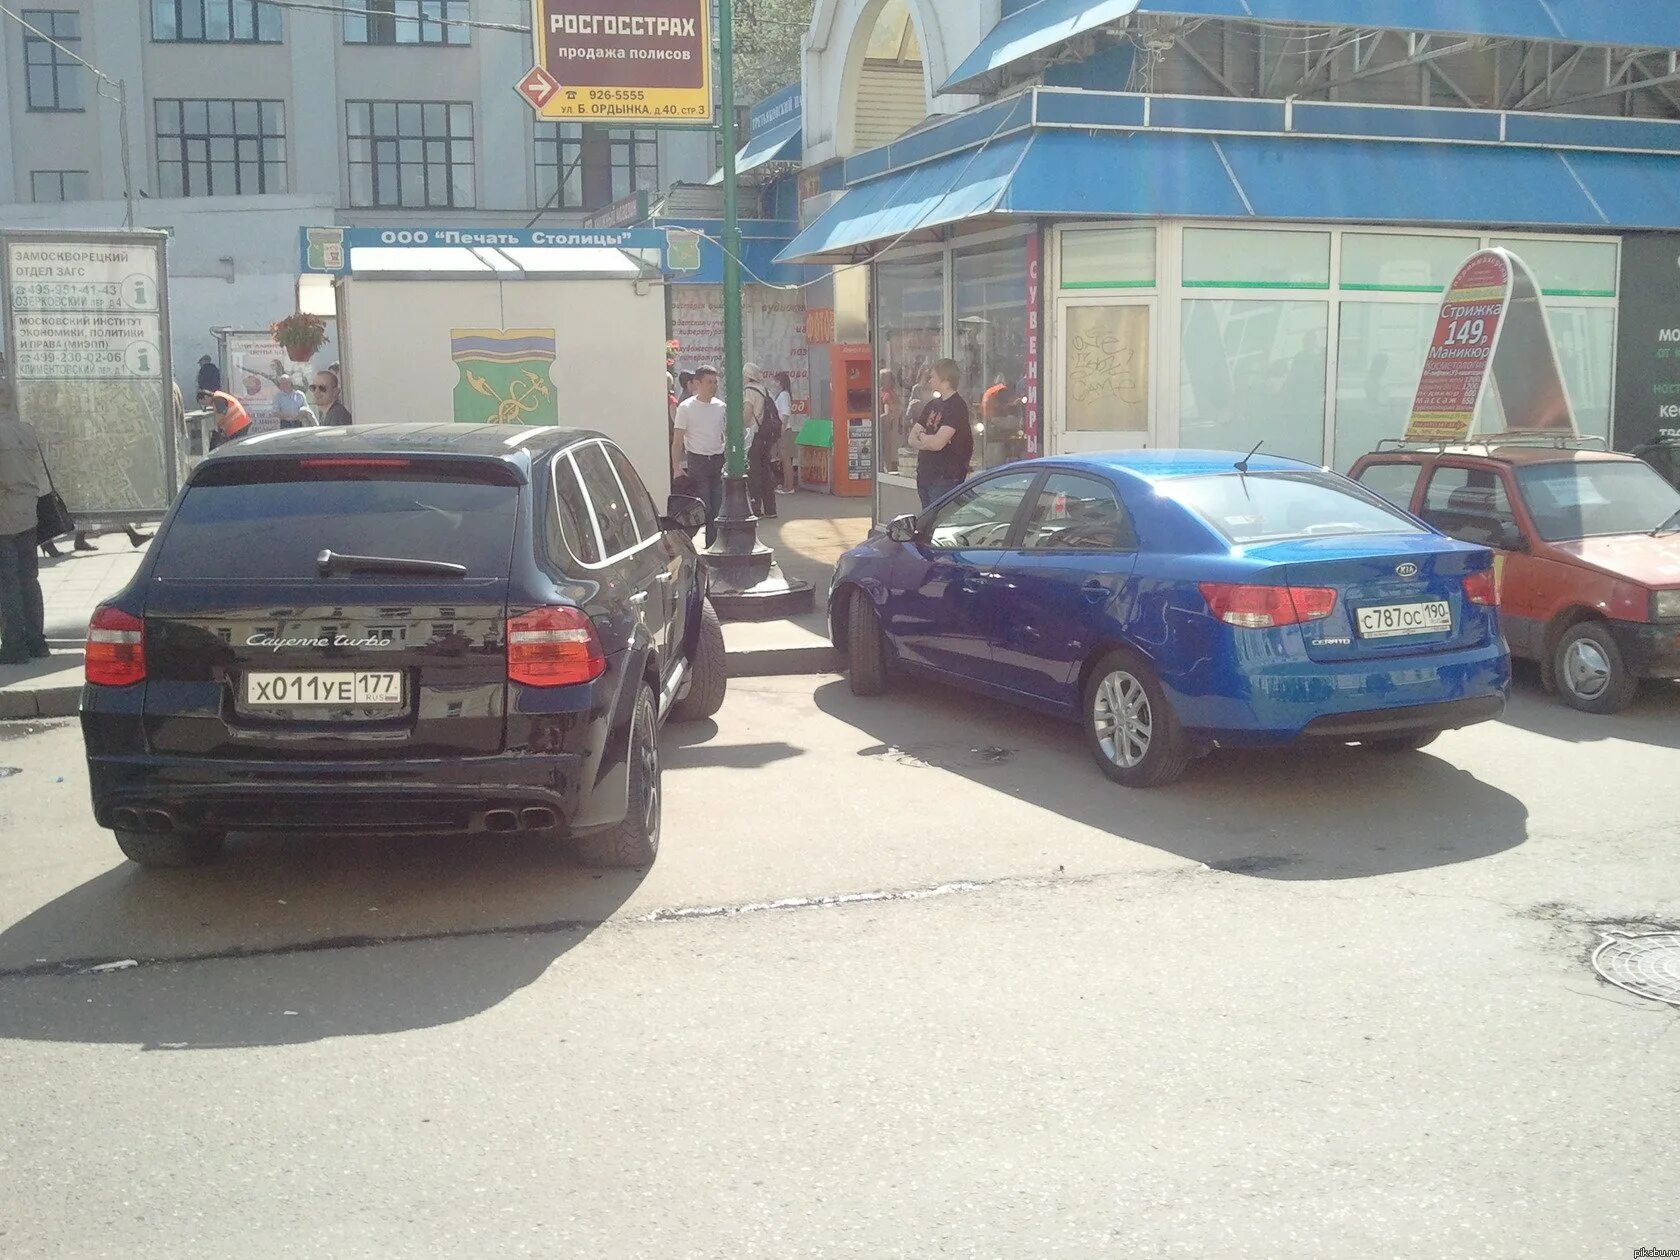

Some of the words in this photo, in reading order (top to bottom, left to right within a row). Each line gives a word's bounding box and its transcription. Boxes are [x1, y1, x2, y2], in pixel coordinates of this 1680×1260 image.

[551, 14, 695, 36] РОСГОССТРАХ
[559, 47, 625, 60] продажа
[629, 49, 691, 60] полисов
[589, 90, 645, 100] 926-5555
[381, 231, 428, 244] ООО
[15, 251, 129, 263] ЗАМОСКВОРЕЦКИЙ
[16, 267, 52, 277] ОТДЕЛ
[57, 267, 85, 276] ЗАГС
[1441, 303, 1503, 320] Стрижка
[19, 317, 90, 326] МОСКОВСКИЙ
[93, 318, 142, 326] ИНСТИТУТ
[20, 329, 87, 338] ЭКОНОМИКИ,
[90, 329, 144, 338] ПОЛИТИКИ
[64, 340, 109, 350] (МИЭПП)
[33, 353, 122, 362] 499-230-02-06
[1027, 260, 1038, 454] СУВЕНИРЫ
[1429, 346, 1490, 359] Маникюр
[19, 364, 95, 374] КЛИМЕНТОВСКИЙ
[1400, 565, 1414, 574] KIA
[1424, 603, 1446, 618] 190
[246, 633, 329, 652] Cayenne
[334, 634, 391, 646] turbo
[358, 674, 394, 693] 177
